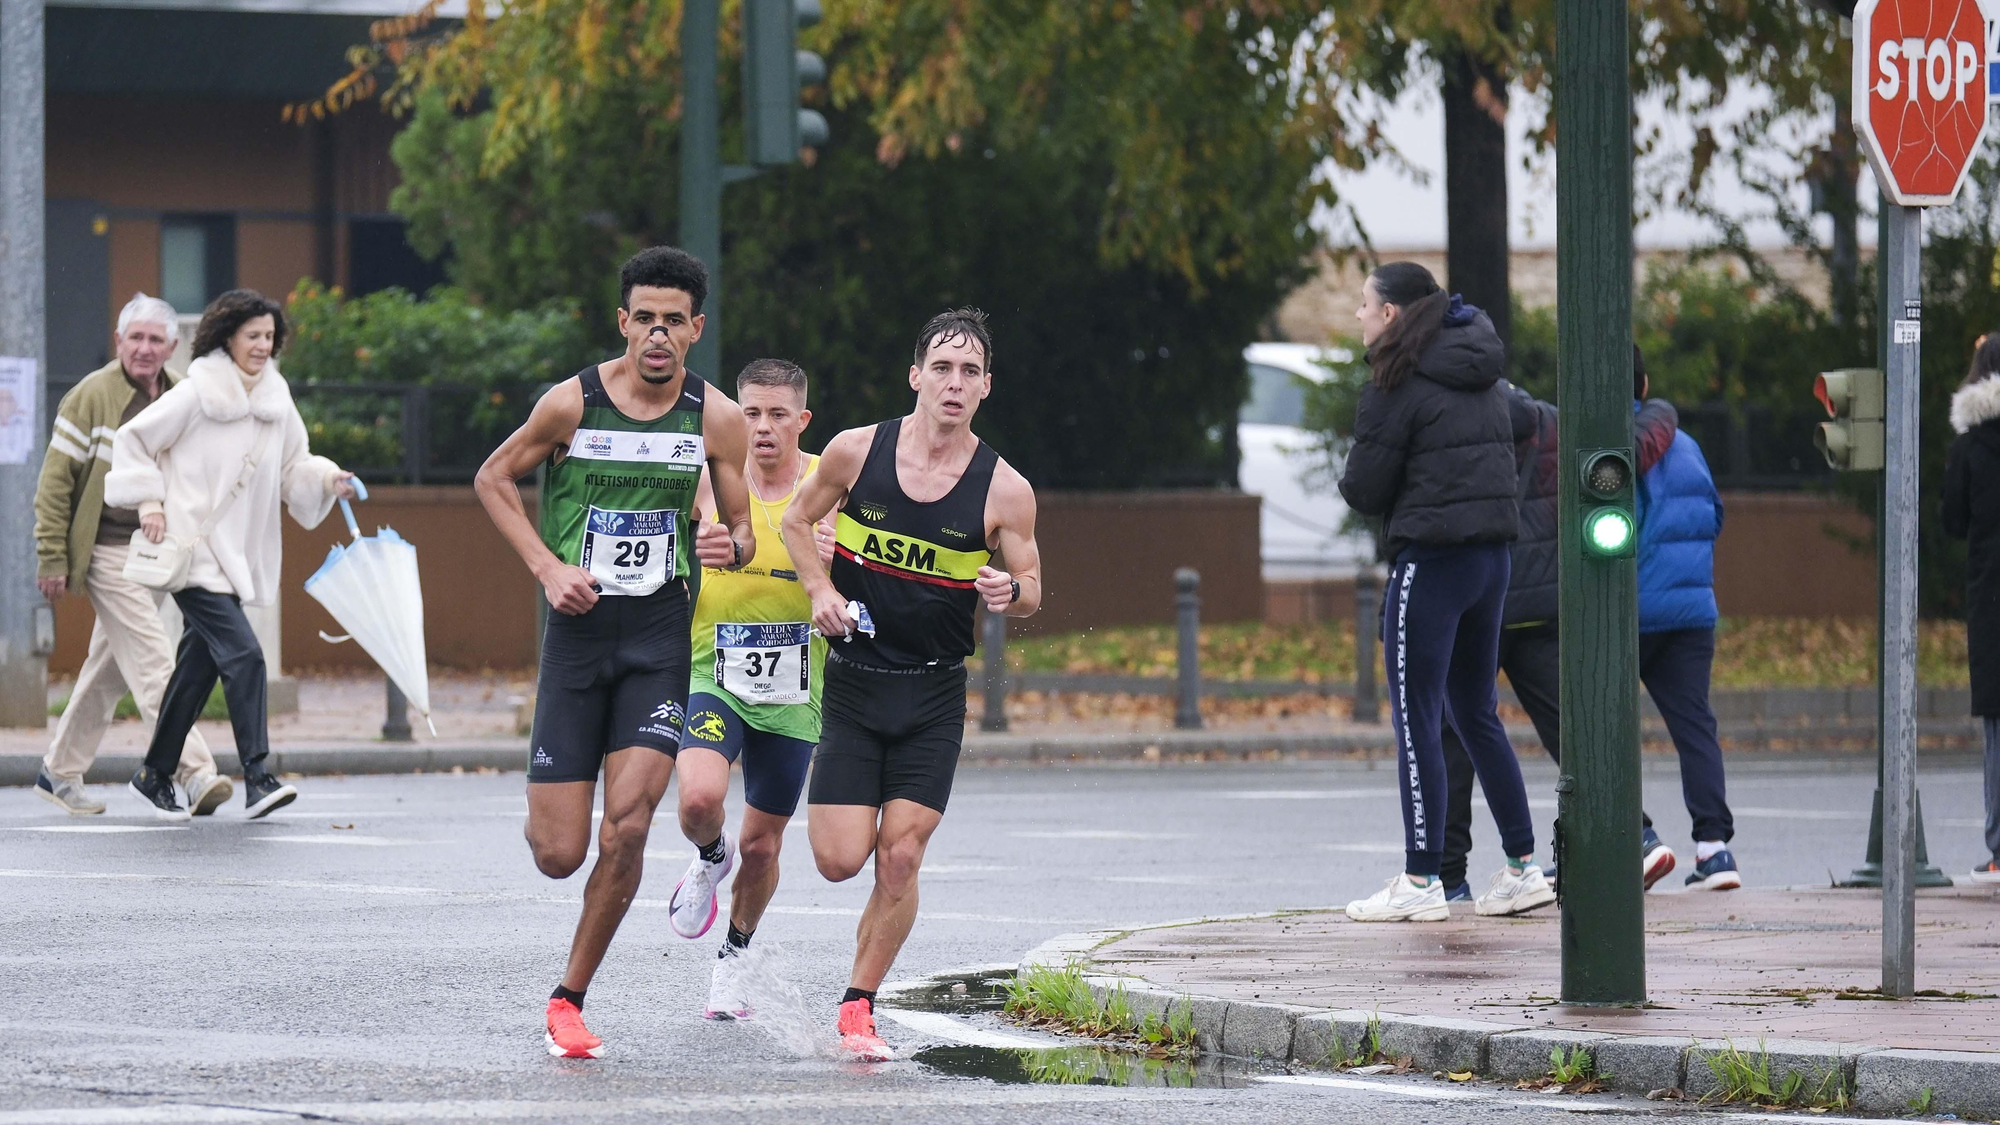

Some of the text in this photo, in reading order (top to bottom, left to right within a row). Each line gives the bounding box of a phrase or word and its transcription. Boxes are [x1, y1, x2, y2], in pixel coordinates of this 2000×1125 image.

[1876, 37, 1977, 101] STOP
[584, 473, 692, 490] ATLETISMO CORDOBÉS
[634, 512, 662, 522] MEDIA
[941, 527, 968, 540] GSPORT
[613, 540, 650, 568] 29
[862, 533, 937, 572] ASM
[760, 624, 792, 634] MEDIA
[745, 651, 781, 677] 37
